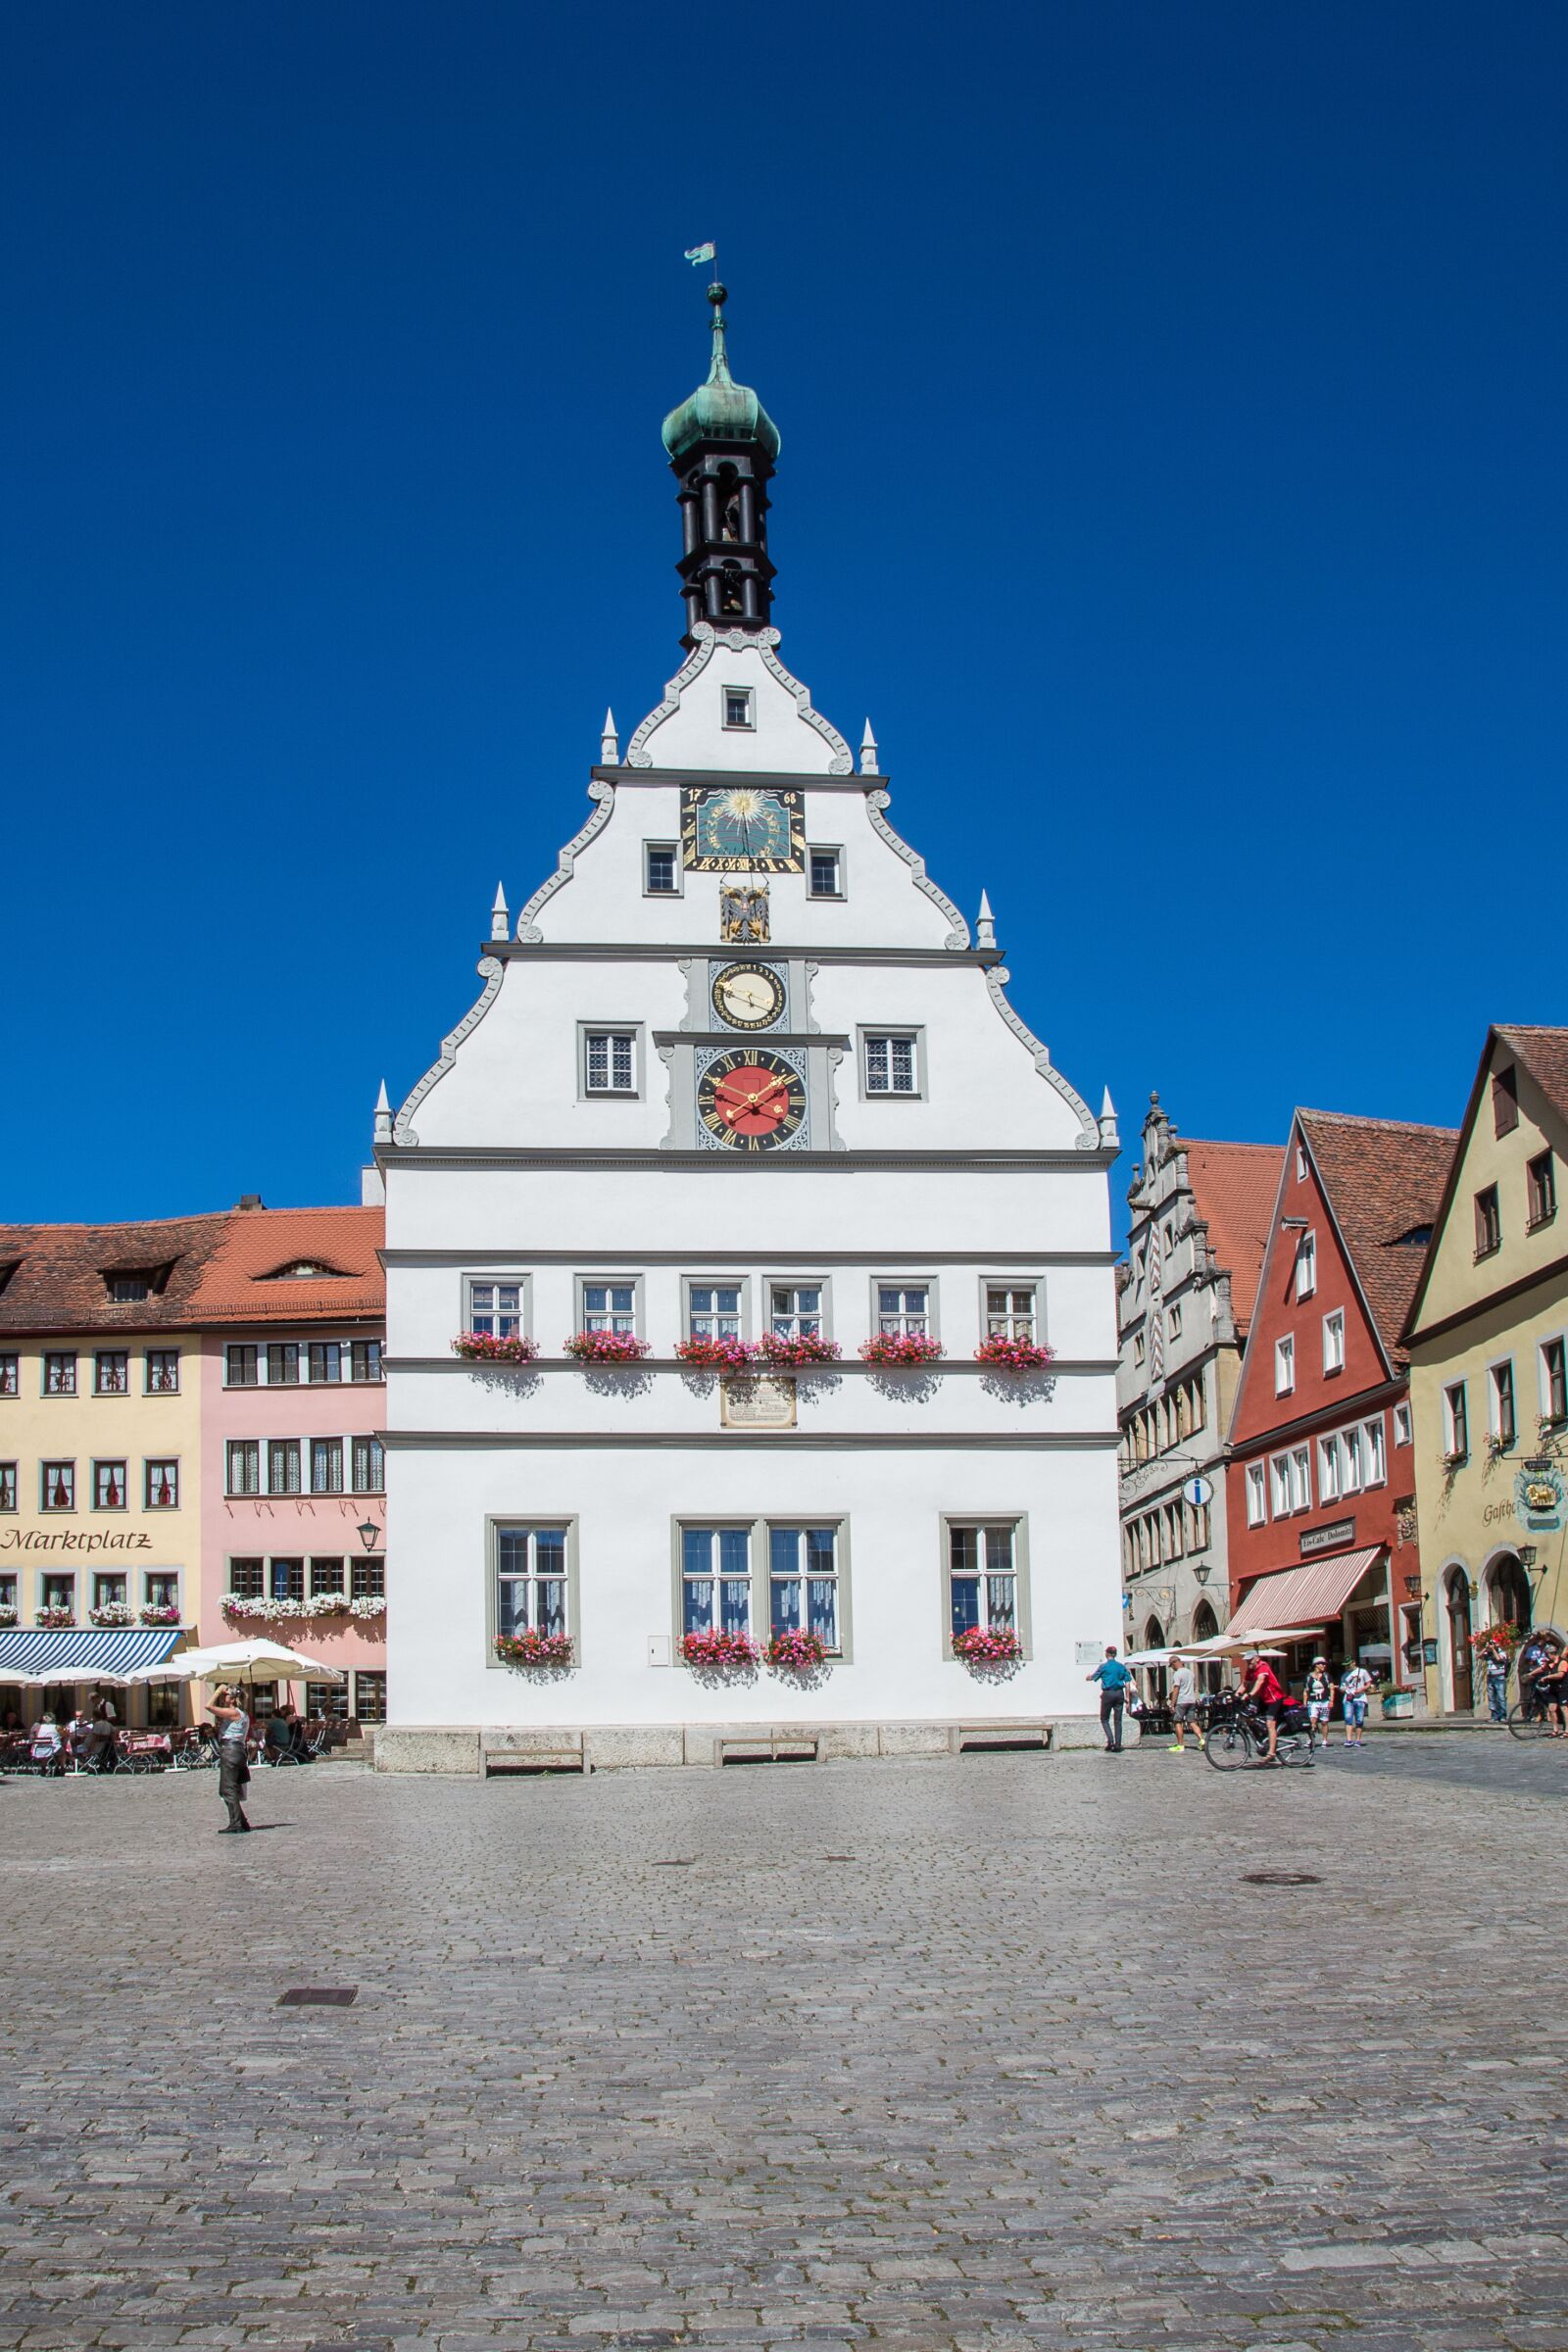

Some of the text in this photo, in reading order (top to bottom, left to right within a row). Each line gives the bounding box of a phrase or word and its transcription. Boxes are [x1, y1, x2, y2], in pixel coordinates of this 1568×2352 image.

[688, 788, 703, 802] 17
[784, 792, 797, 804] 68
[697, 857, 714, 870] IX
[714, 858, 726, 870] X
[720, 1054, 736, 1072] XI
[744, 1051, 758, 1065] XII
[769, 1056, 778, 1070] I
[783, 1073, 799, 1085] II
[698, 1095, 714, 1104] IX
[790, 1097, 806, 1105] III
[704, 1111, 722, 1132] VIII
[721, 1129, 738, 1147] VII
[772, 1132, 784, 1147] V
[1327, 1525, 1352, 1541] Dolomiti
[0, 1529, 154, 1553] Marktplatz
